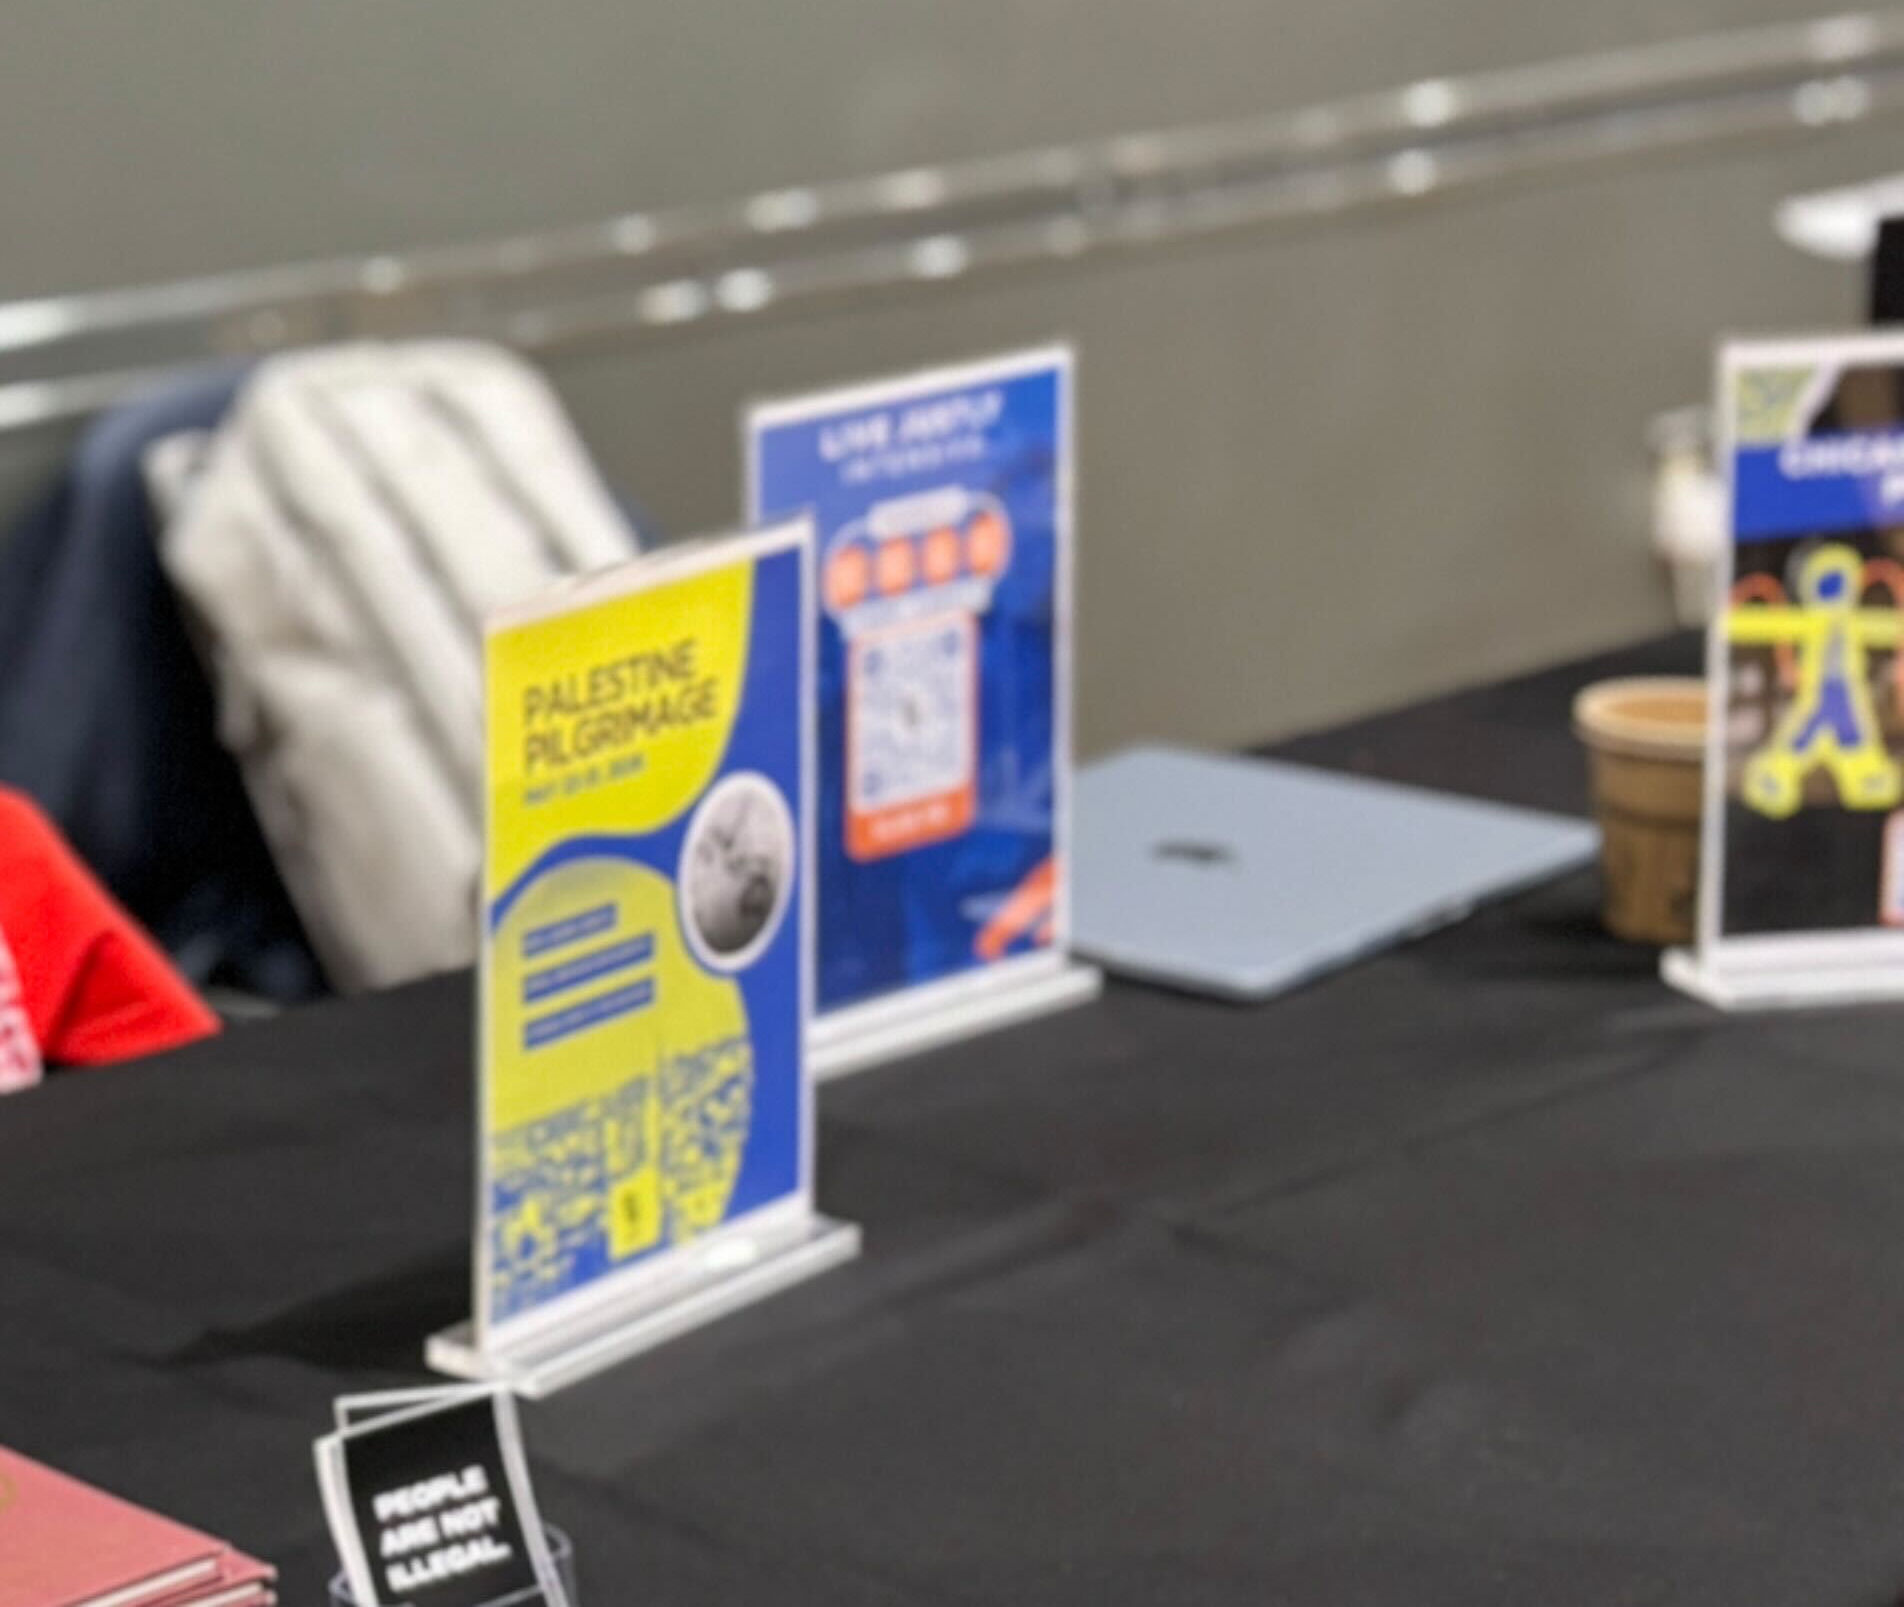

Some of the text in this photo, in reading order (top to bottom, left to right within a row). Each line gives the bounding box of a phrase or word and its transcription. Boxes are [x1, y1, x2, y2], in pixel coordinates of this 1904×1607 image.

[522, 637, 698, 726] PALESTINE
[522, 676, 719, 775] PILGRIMAGE
[372, 1464, 490, 1522] PEOPLE
[379, 1496, 501, 1559] ARE NOT
[385, 1535, 513, 1592] ILLEGAL.
